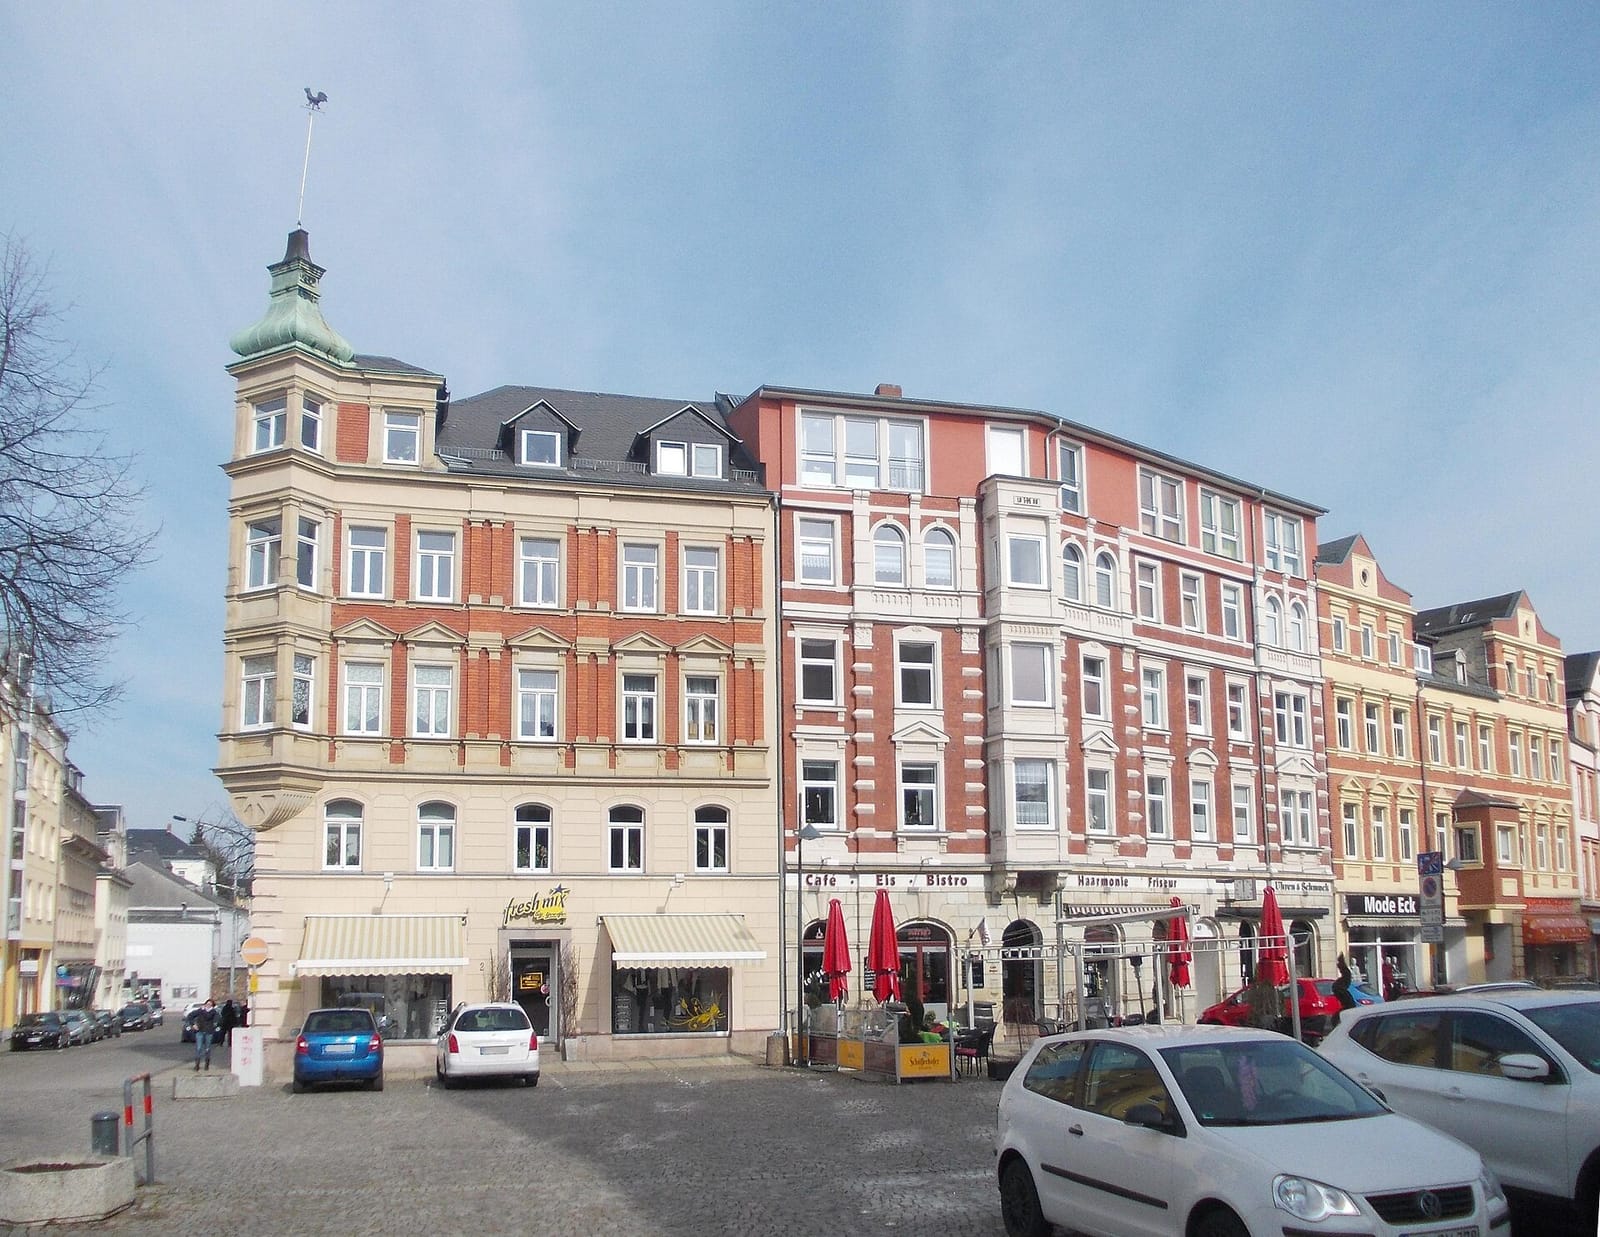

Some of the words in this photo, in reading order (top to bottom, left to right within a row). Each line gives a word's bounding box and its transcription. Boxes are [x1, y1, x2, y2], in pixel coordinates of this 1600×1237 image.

[806, 874, 837, 886] Café
[876, 874, 896, 886] Eis
[926, 874, 968, 886] Bistro
[1078, 875, 1129, 888] Haarmonie
[1148, 877, 1177, 888] Friseur
[504, 892, 540, 925] fresh
[542, 892, 567, 908] mix
[1364, 896, 1396, 913] Mode
[1397, 896, 1416, 913] Eck
[479, 961, 485, 972] 2
